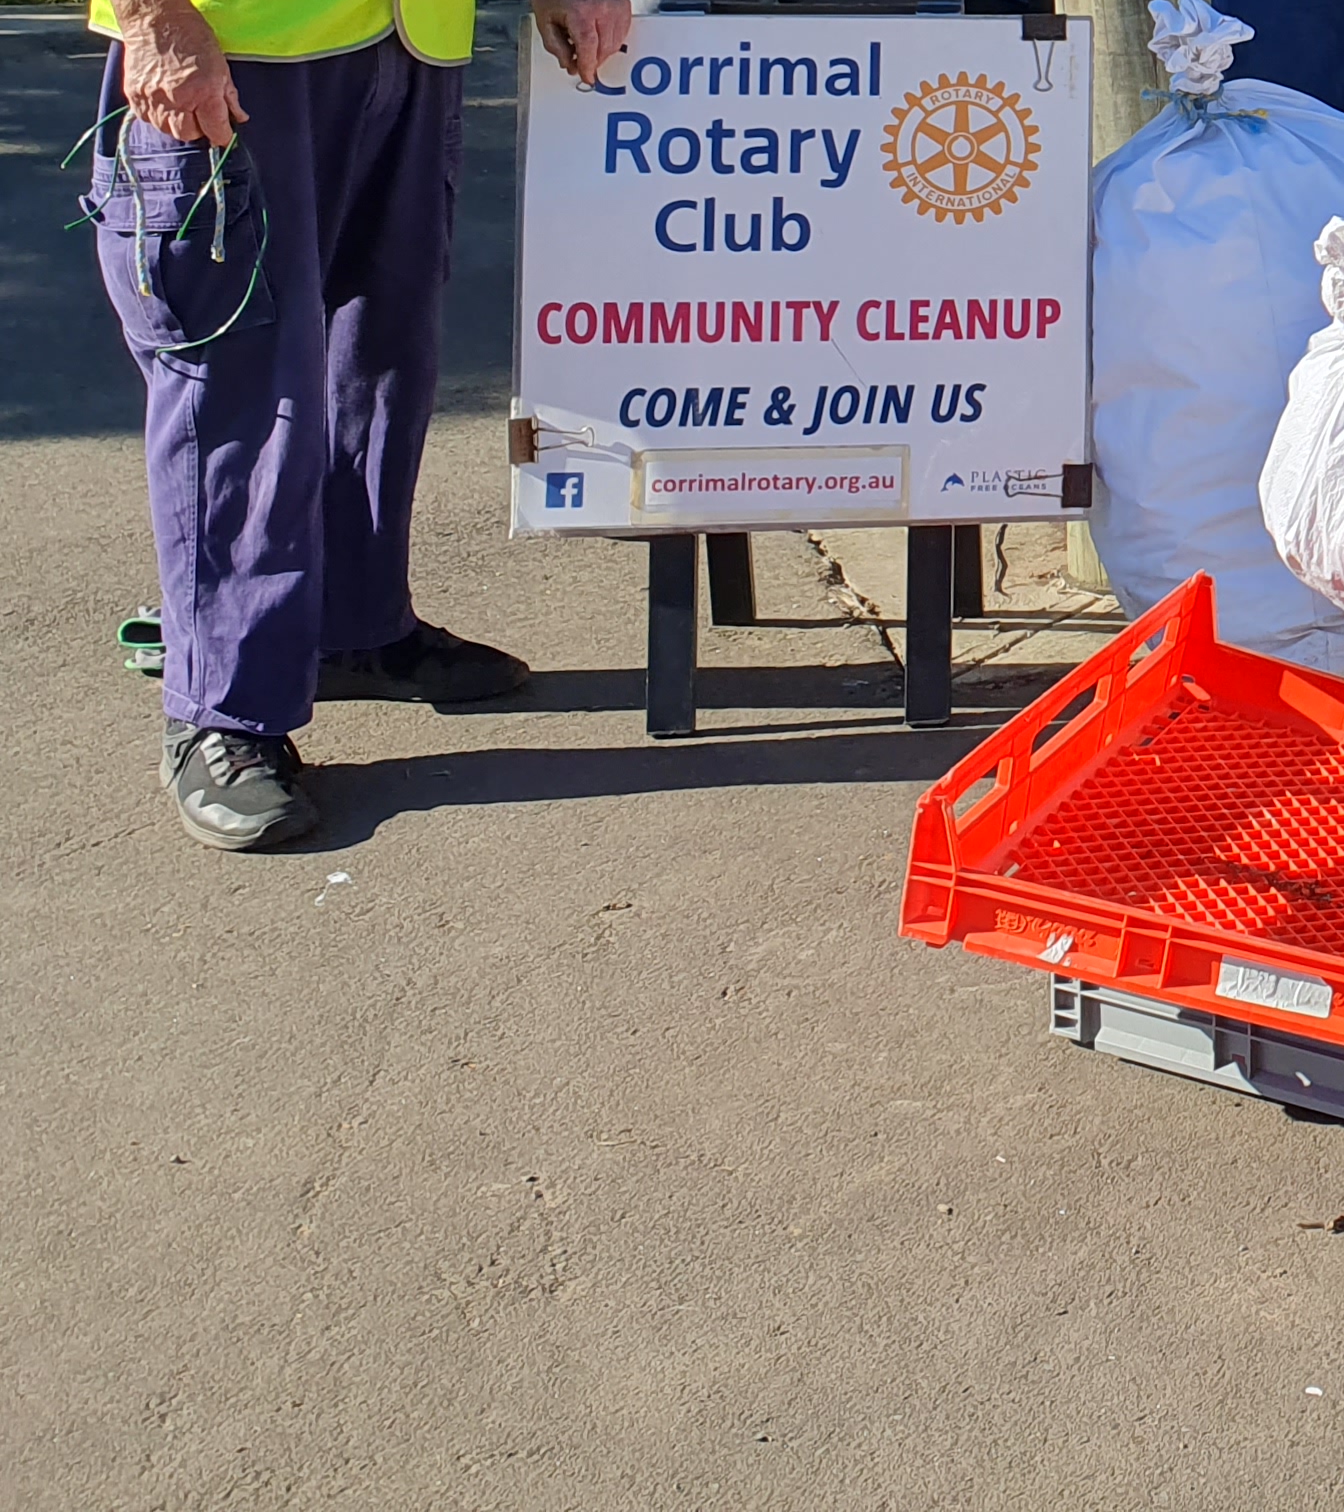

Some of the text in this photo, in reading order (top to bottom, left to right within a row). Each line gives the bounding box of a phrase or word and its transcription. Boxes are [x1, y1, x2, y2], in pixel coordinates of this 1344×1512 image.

[929, 88, 995, 106] ROTARY
[604, 111, 861, 188] Rotary
[906, 171, 1017, 208] INTERNATIONAL
[654, 197, 812, 252] Club
[536, 298, 1062, 345] COMMUNITY CLEANUP
[618, 383, 987, 435] COME & JOIN US
[651, 472, 895, 495] corrimalrotary.org.au
[970, 468, 1048, 484] PLASTIC
